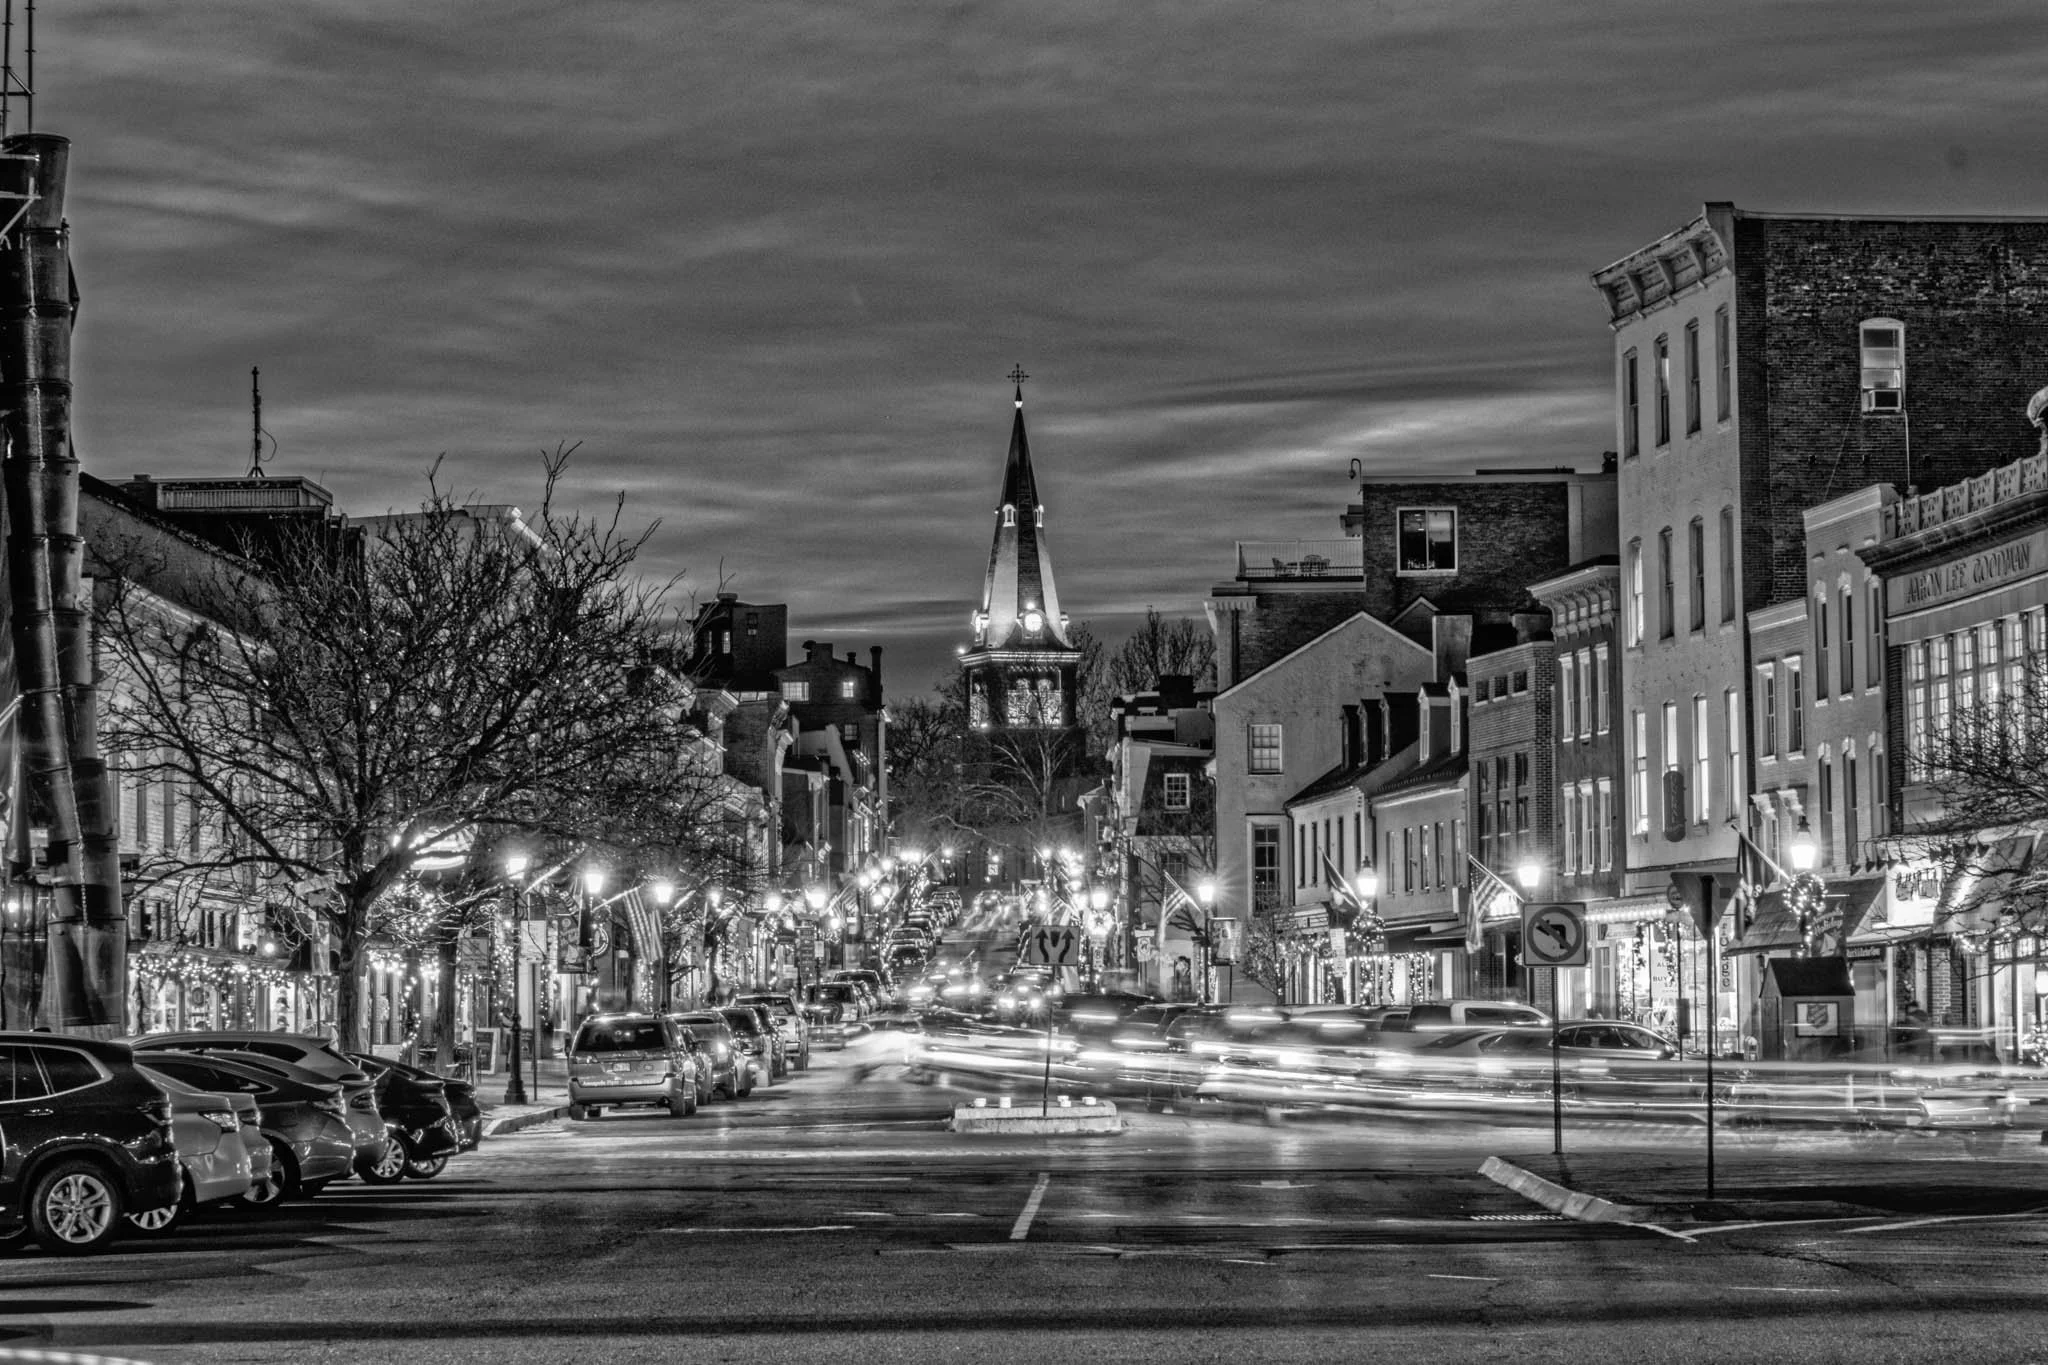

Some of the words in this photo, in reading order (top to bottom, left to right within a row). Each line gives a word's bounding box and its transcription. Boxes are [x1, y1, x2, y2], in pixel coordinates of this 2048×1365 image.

[1906, 571, 1942, 604] AARON
[1946, 562, 1967, 593] LEE
[1973, 542, 2030, 584] GOODMAN
